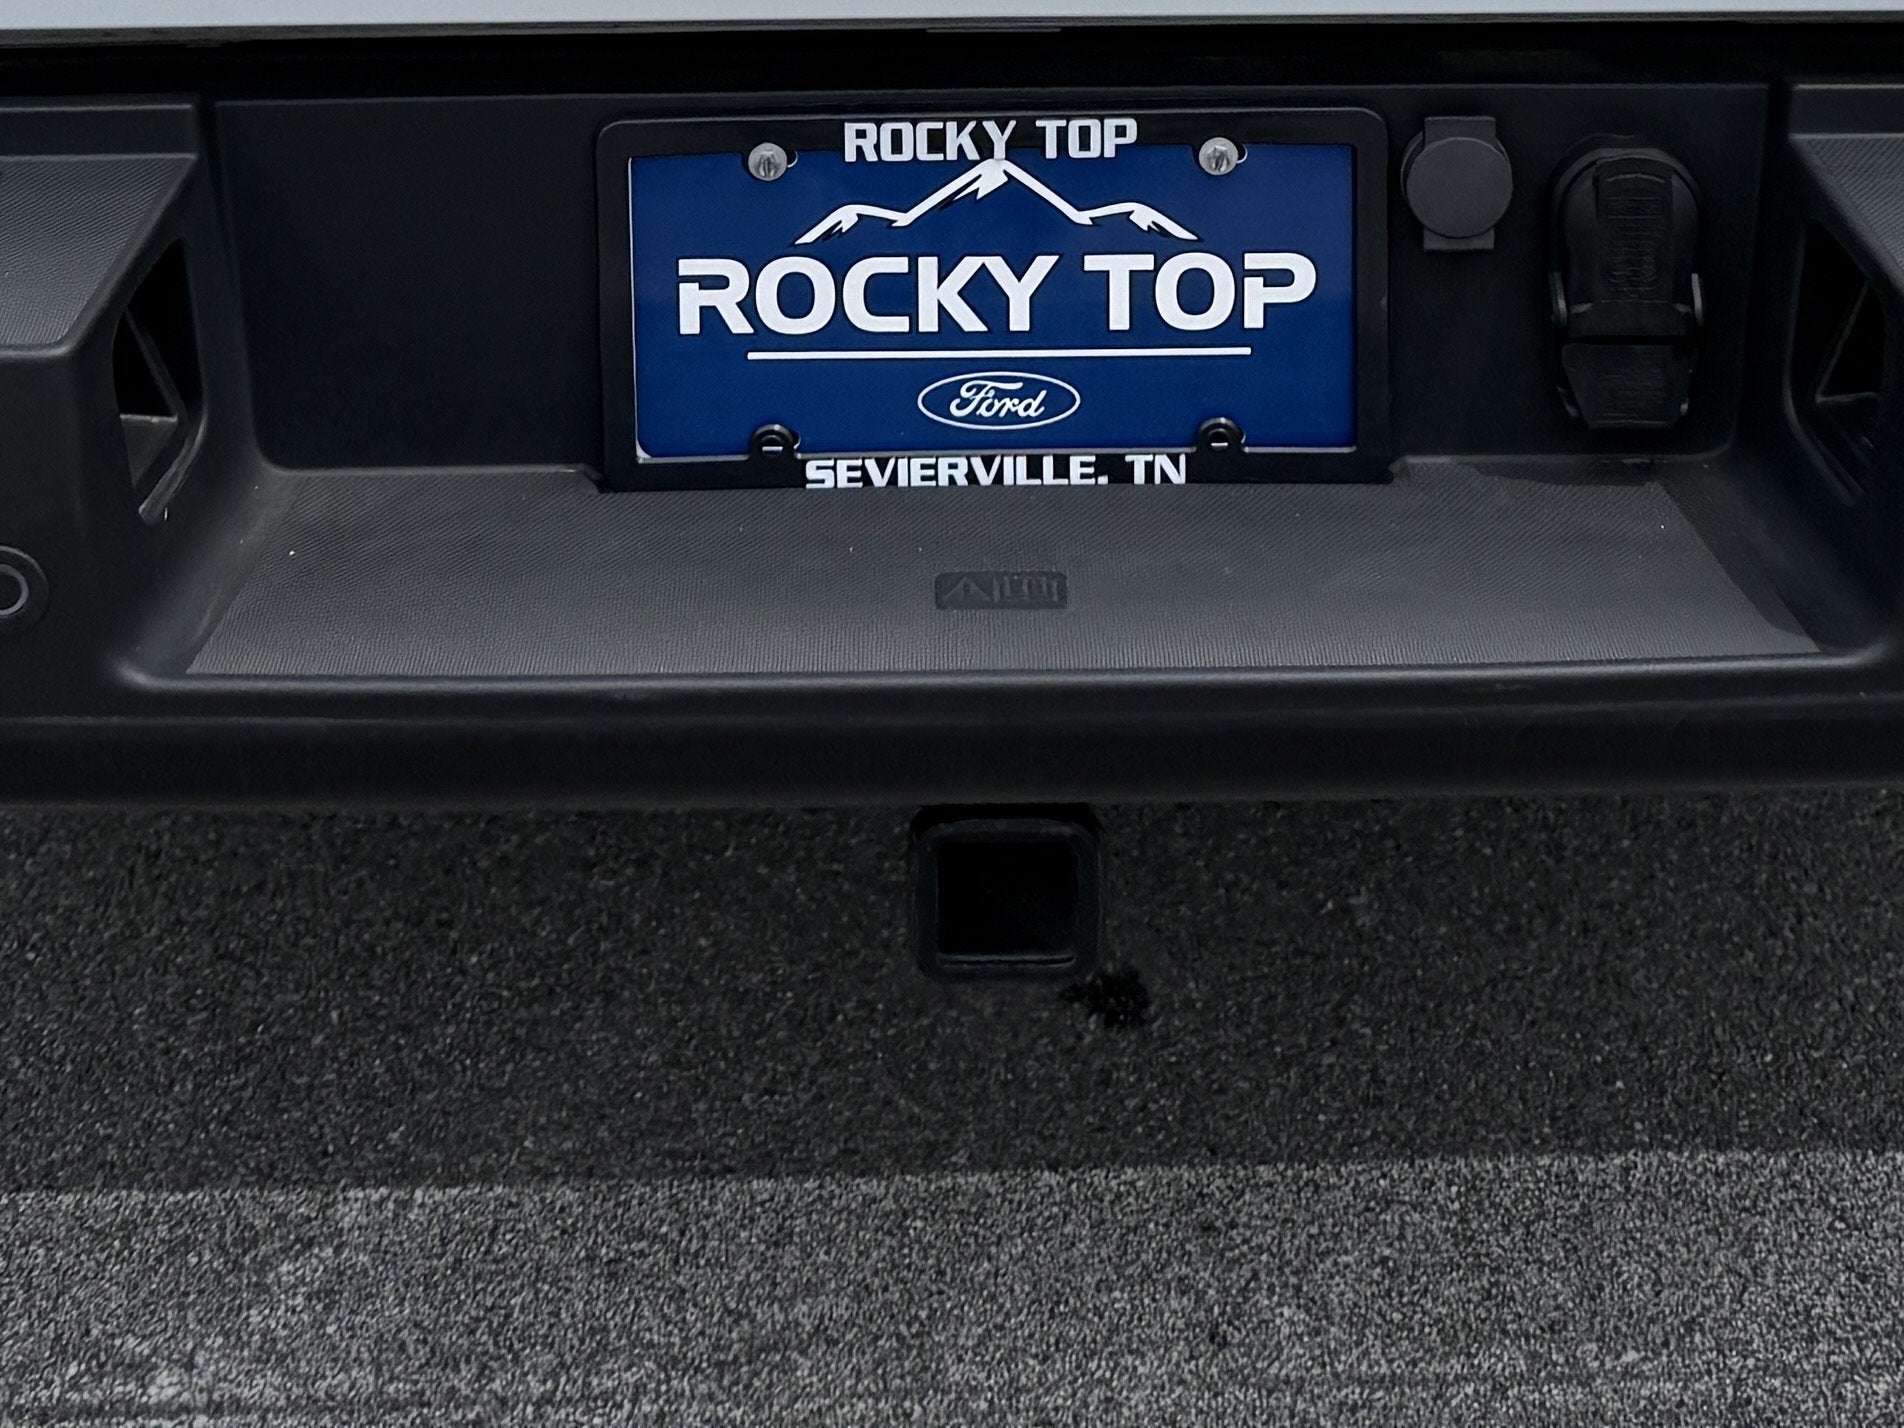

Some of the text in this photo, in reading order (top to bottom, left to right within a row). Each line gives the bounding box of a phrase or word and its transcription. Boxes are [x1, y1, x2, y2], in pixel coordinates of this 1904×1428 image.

[844, 117, 1138, 163] ROCKY TOP
[678, 251, 1318, 335] ROCKY TOP
[949, 379, 1047, 420] Ford
[1128, 452, 1187, 486] TN
